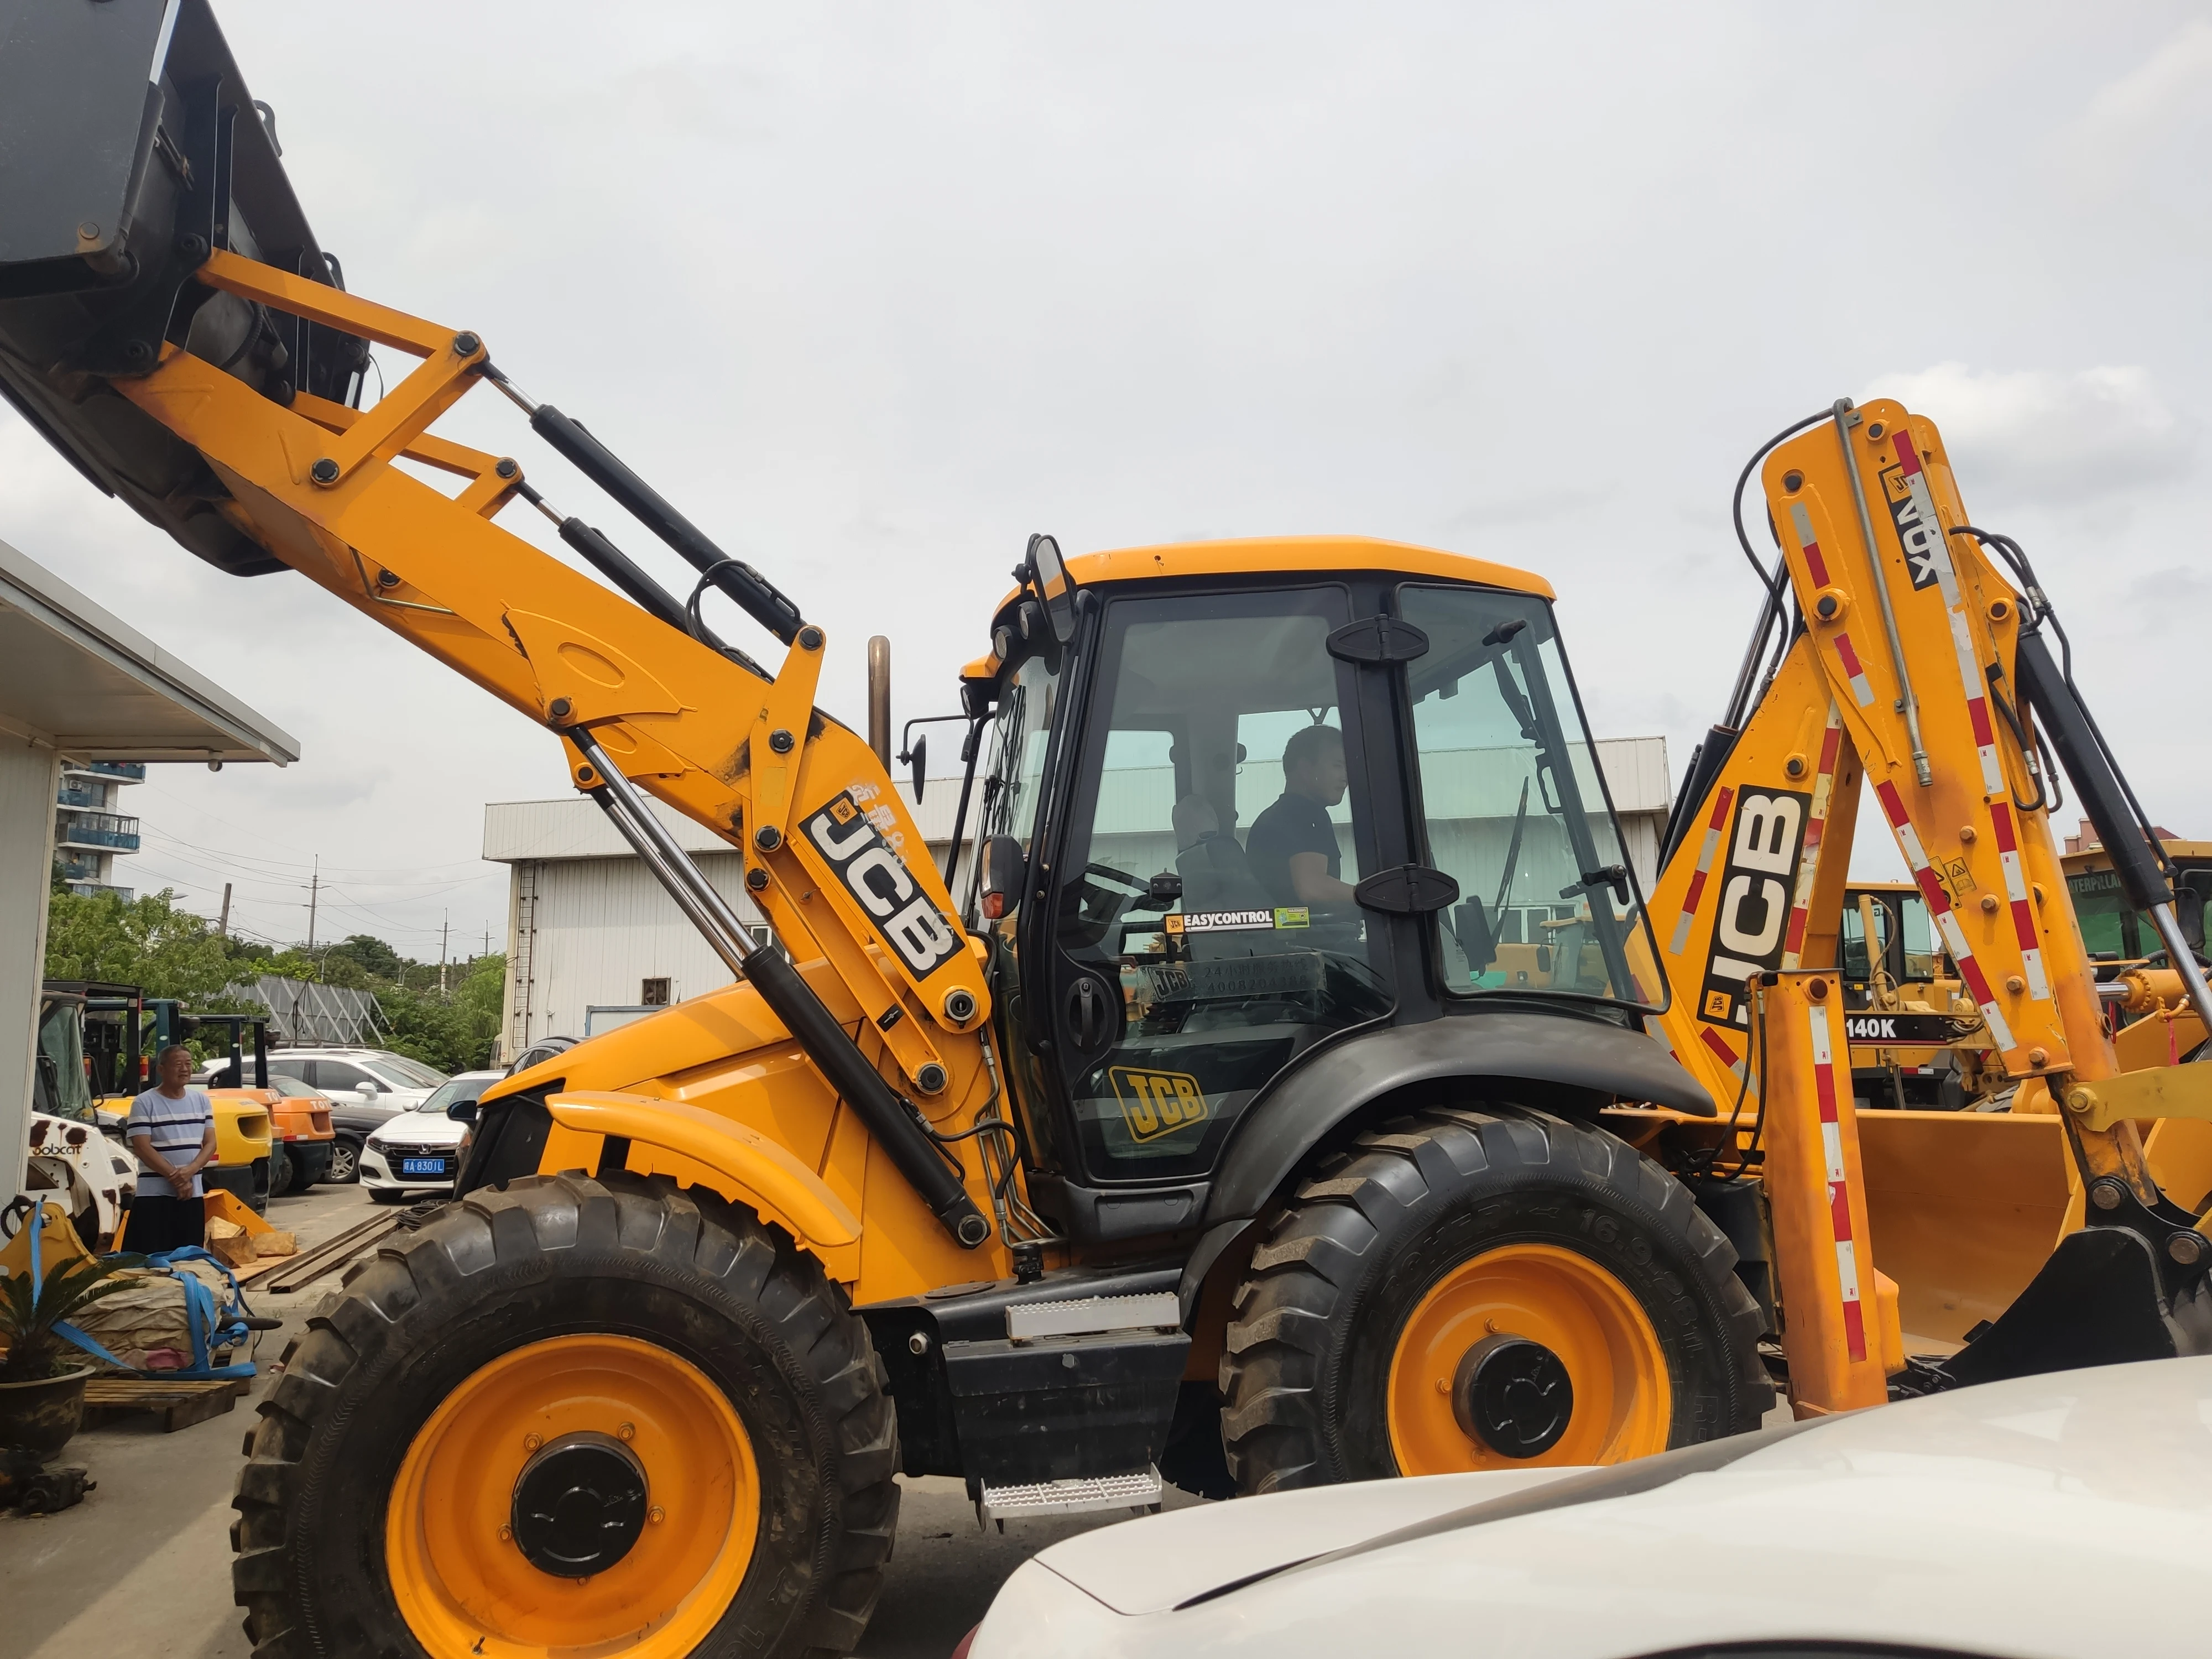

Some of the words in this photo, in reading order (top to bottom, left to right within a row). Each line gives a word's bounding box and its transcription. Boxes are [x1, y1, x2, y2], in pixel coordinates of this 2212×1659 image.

[838, 804, 849, 818] JCB
[811, 813, 953, 970] JCB
[2068, 873, 2121, 893] ATERPILLA
[1171, 920, 1181, 928] JCB
[1184, 910, 1272, 928] EASYCONTROL
[1712, 795, 1801, 1026] JCB
[1156, 969, 1188, 995] JCB
[1712, 997, 1723, 1010] JCB
[1846, 1018, 1897, 1038] 140K
[1127, 1074, 1201, 1134] JCB
